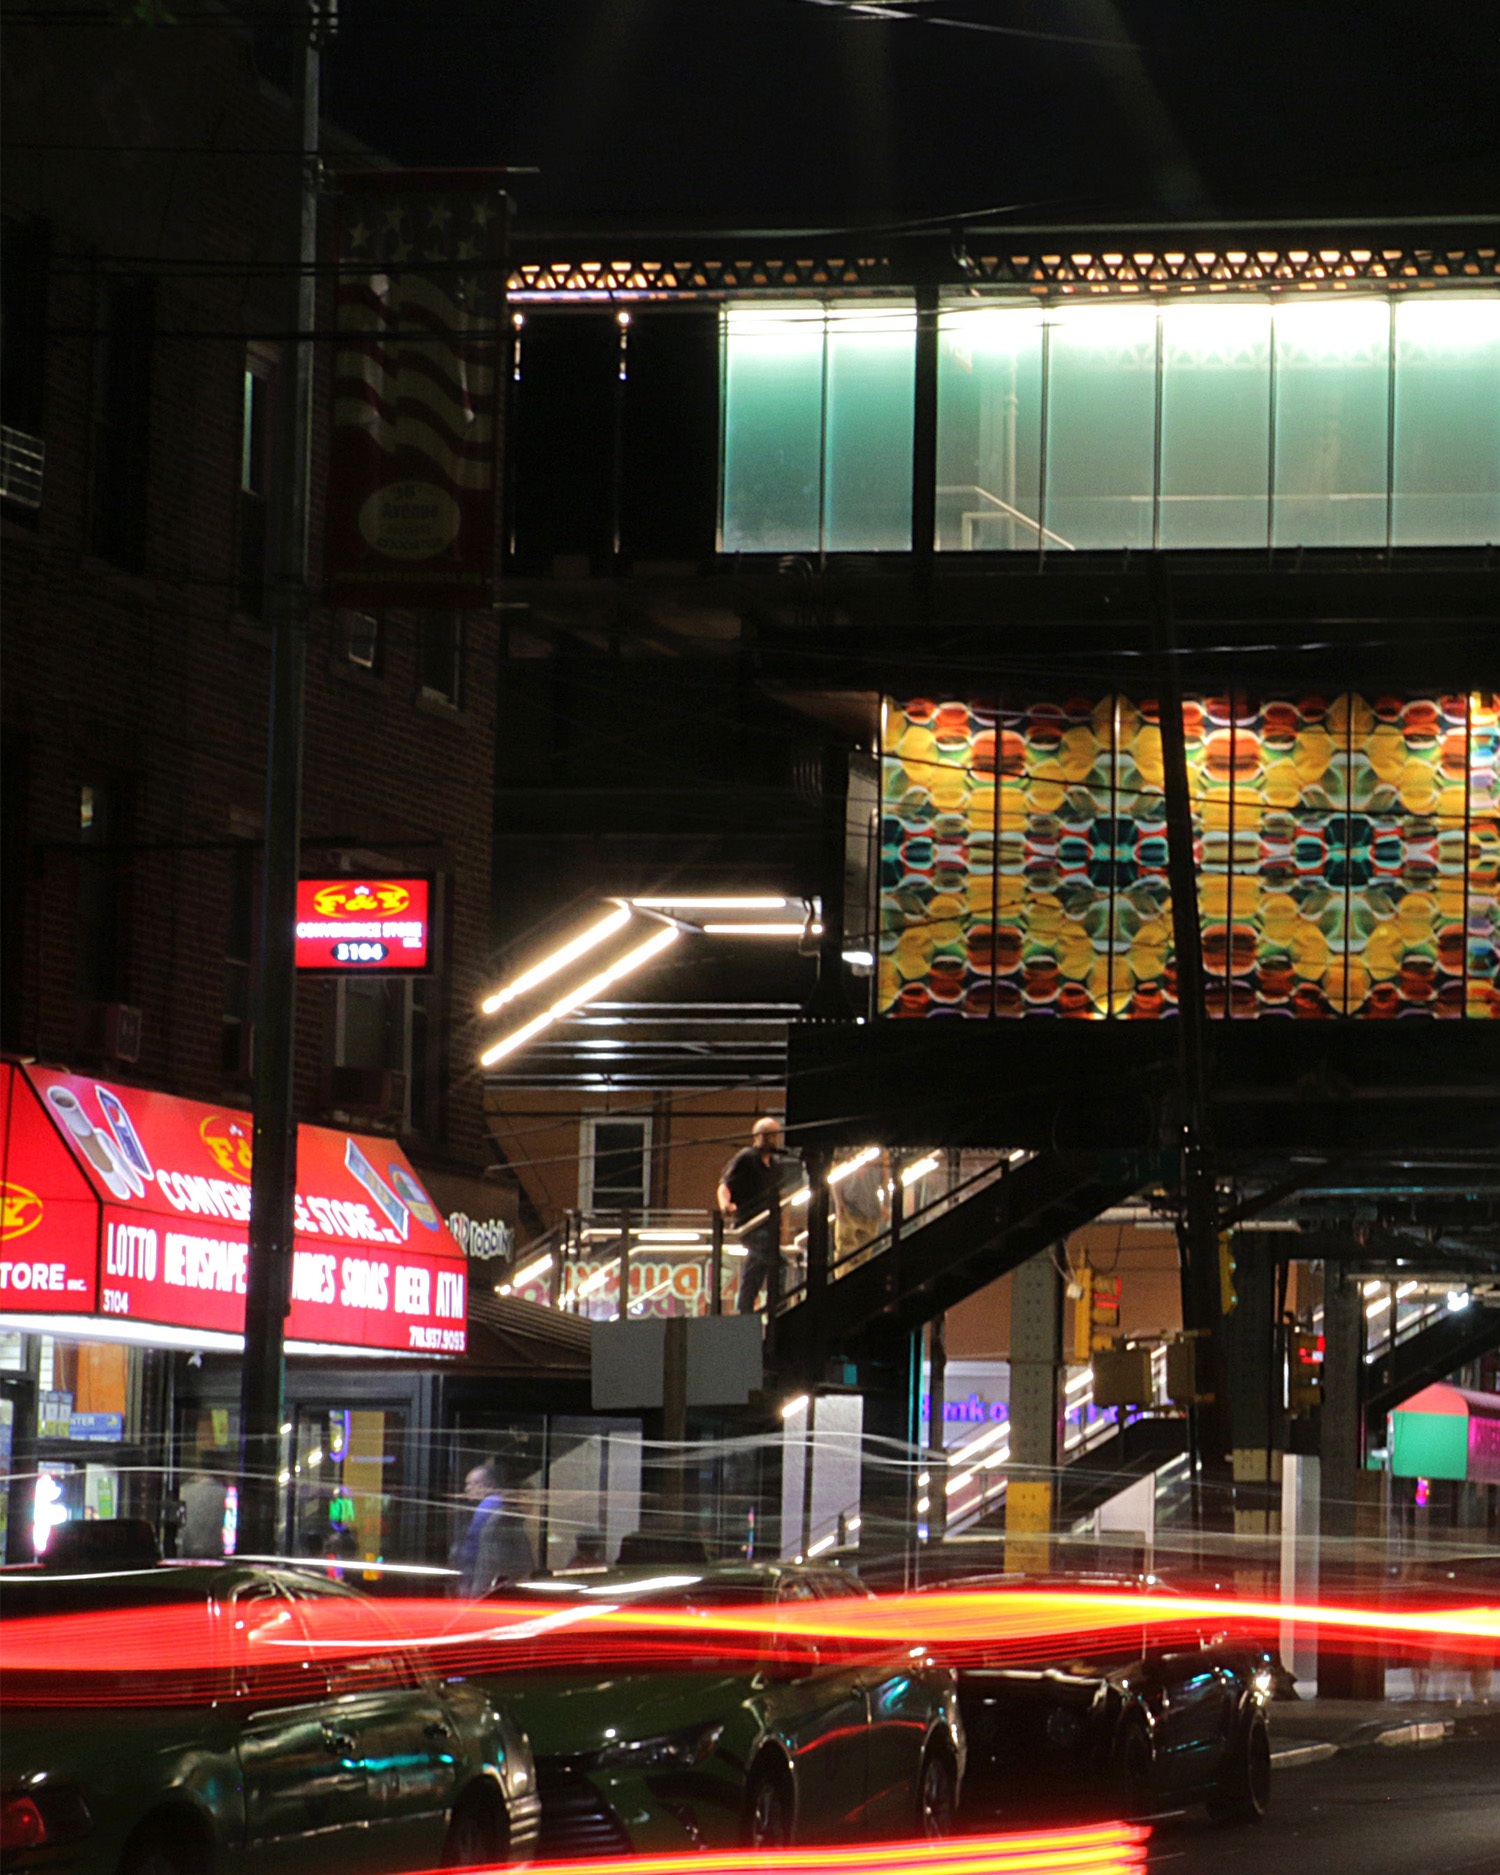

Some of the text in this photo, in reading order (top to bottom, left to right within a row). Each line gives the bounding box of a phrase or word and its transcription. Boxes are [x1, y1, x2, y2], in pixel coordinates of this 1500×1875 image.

[382, 922, 422, 938] STORE
[338, 943, 382, 960] 3104
[156, 1169, 319, 1232] CONVENCE
[306, 1195, 384, 1242] STORE
[0, 1262, 66, 1290] TORE
[107, 1222, 157, 1281] LOTTO
[164, 1232, 248, 1294] NEWSPAPE
[293, 1252, 336, 1304] NDIES
[341, 1257, 389, 1311] SODAS
[394, 1265, 430, 1316] BEER
[436, 1271, 464, 1319] ATM
[103, 1290, 129, 1313] 3104
